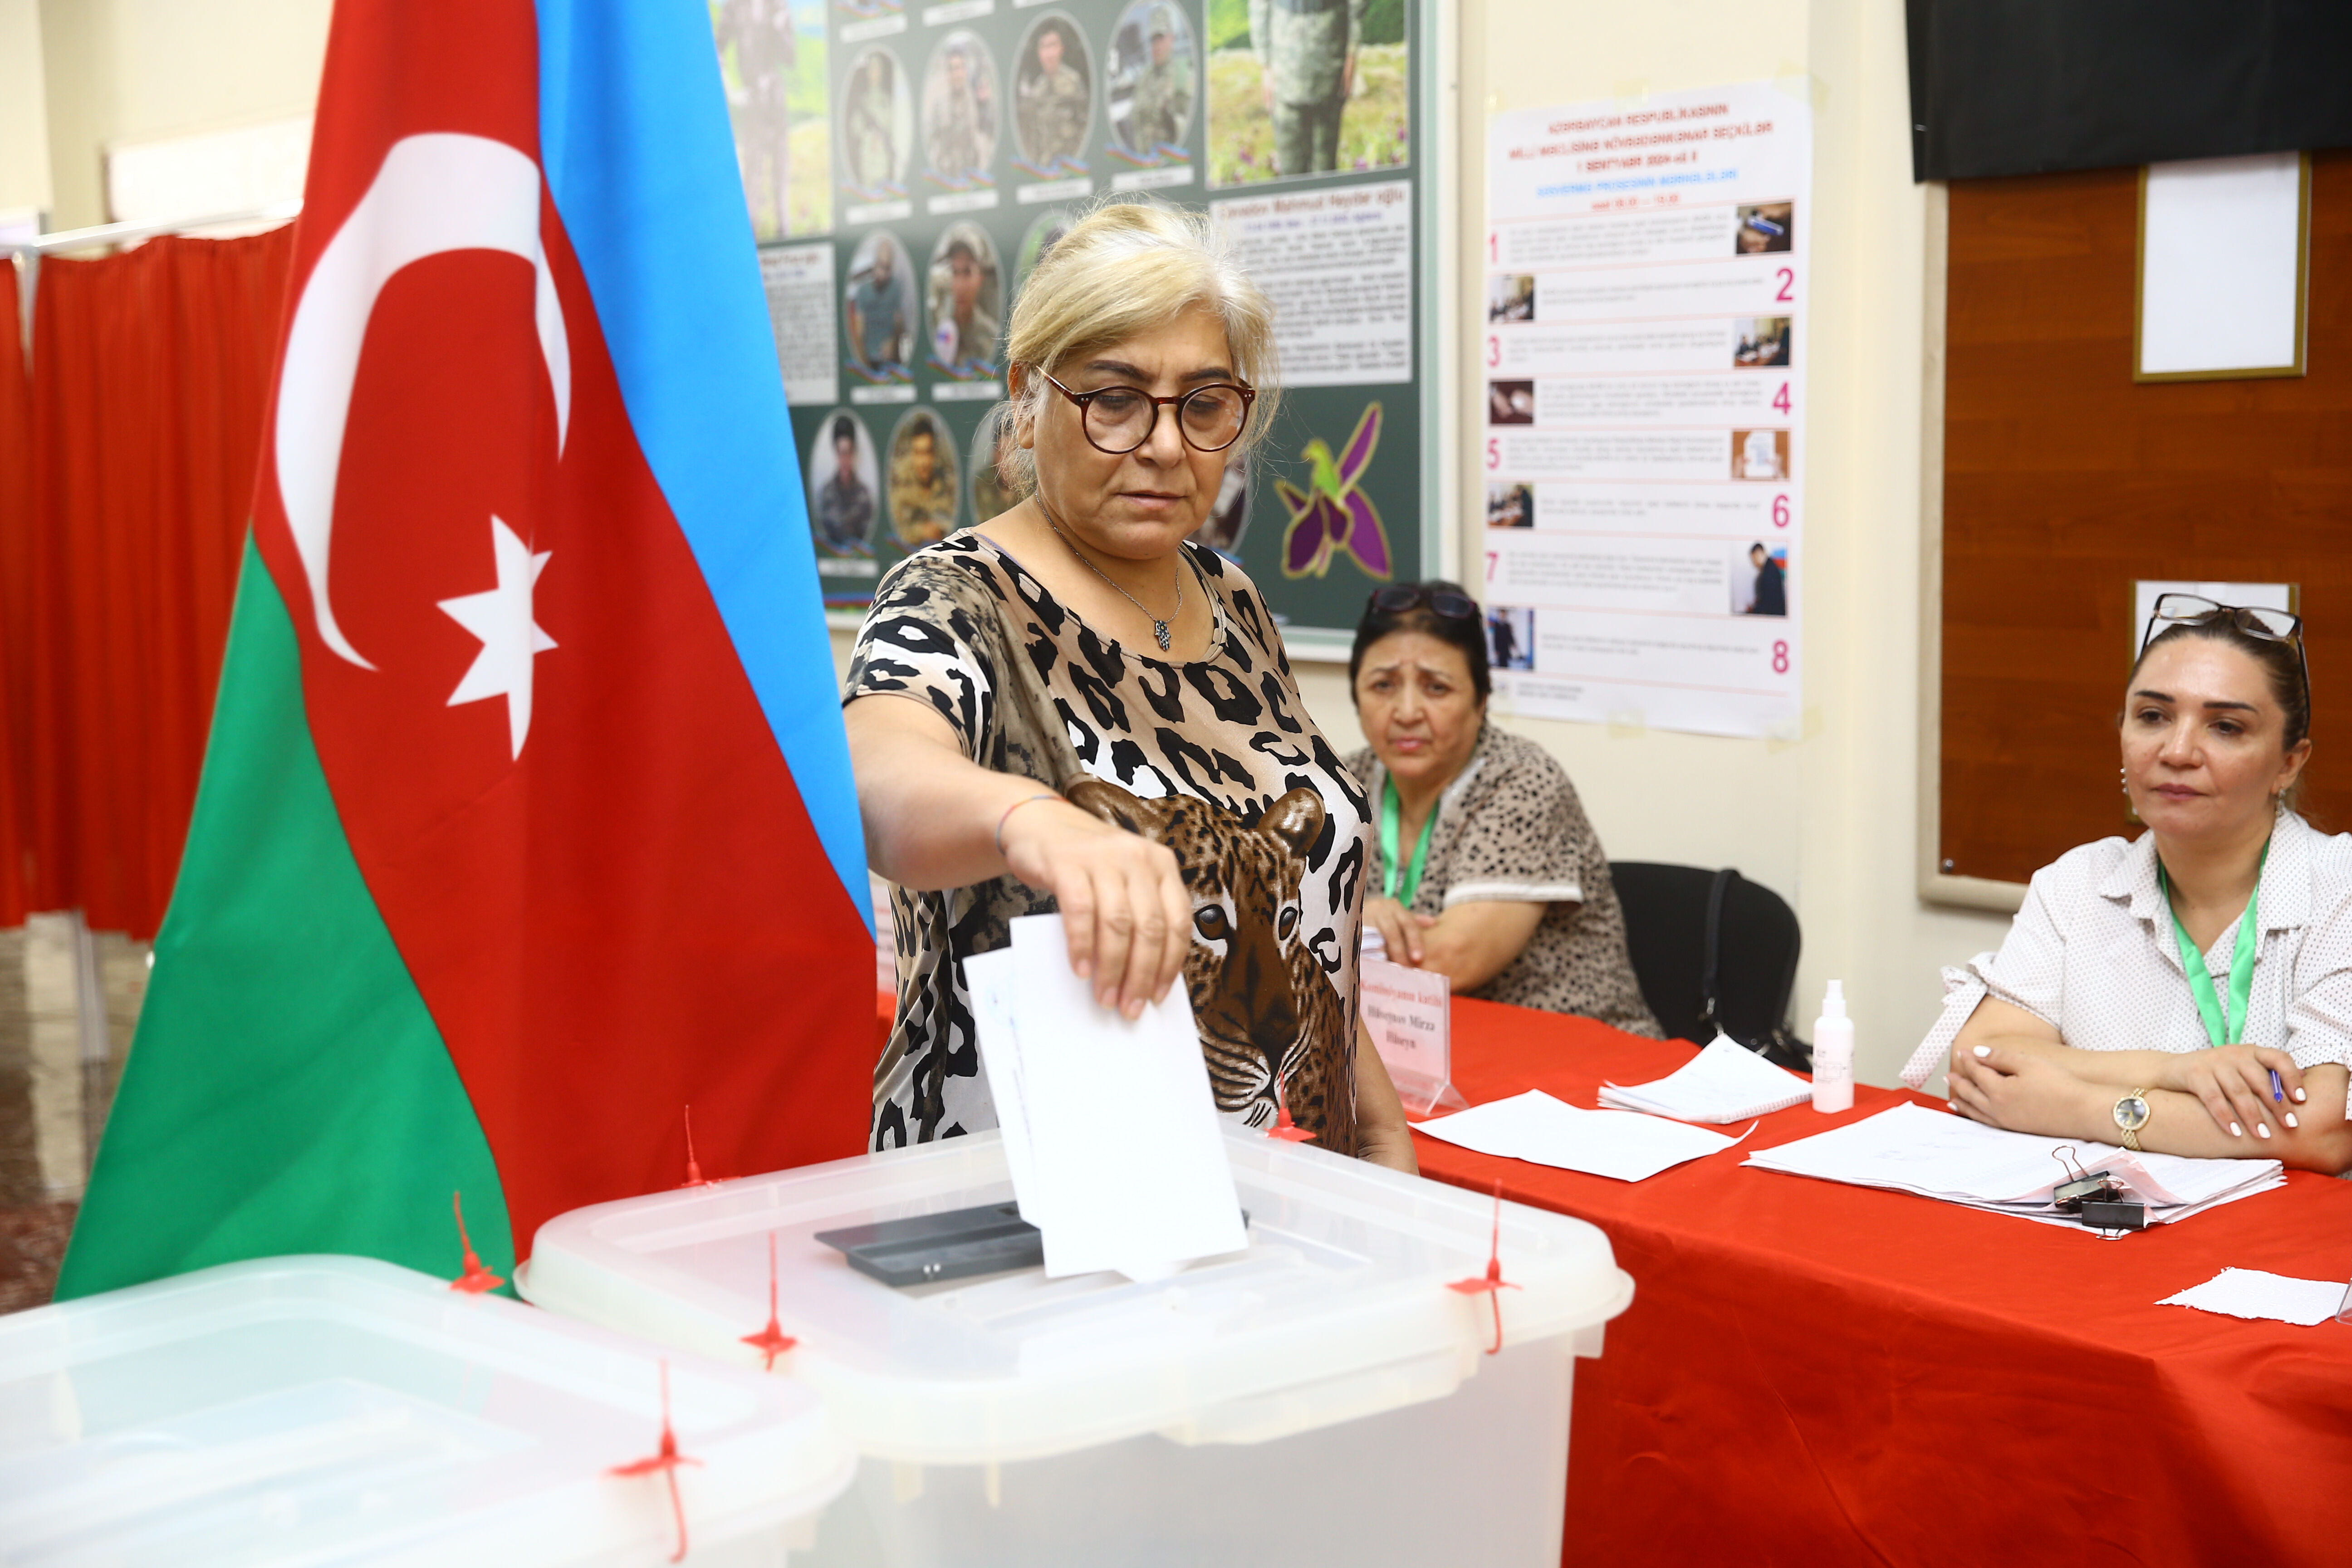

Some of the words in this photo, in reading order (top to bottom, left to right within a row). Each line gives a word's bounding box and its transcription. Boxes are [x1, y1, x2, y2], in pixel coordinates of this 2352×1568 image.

[1488, 233, 1498, 263] 1
[1775, 268, 1794, 301] 2
[1488, 336, 1501, 367] 3
[1772, 382, 1792, 415] 4
[1487, 439, 1500, 469] 5
[1772, 494, 1789, 528] 6
[1485, 552, 1499, 581] 7
[1772, 640, 1789, 673] 8
